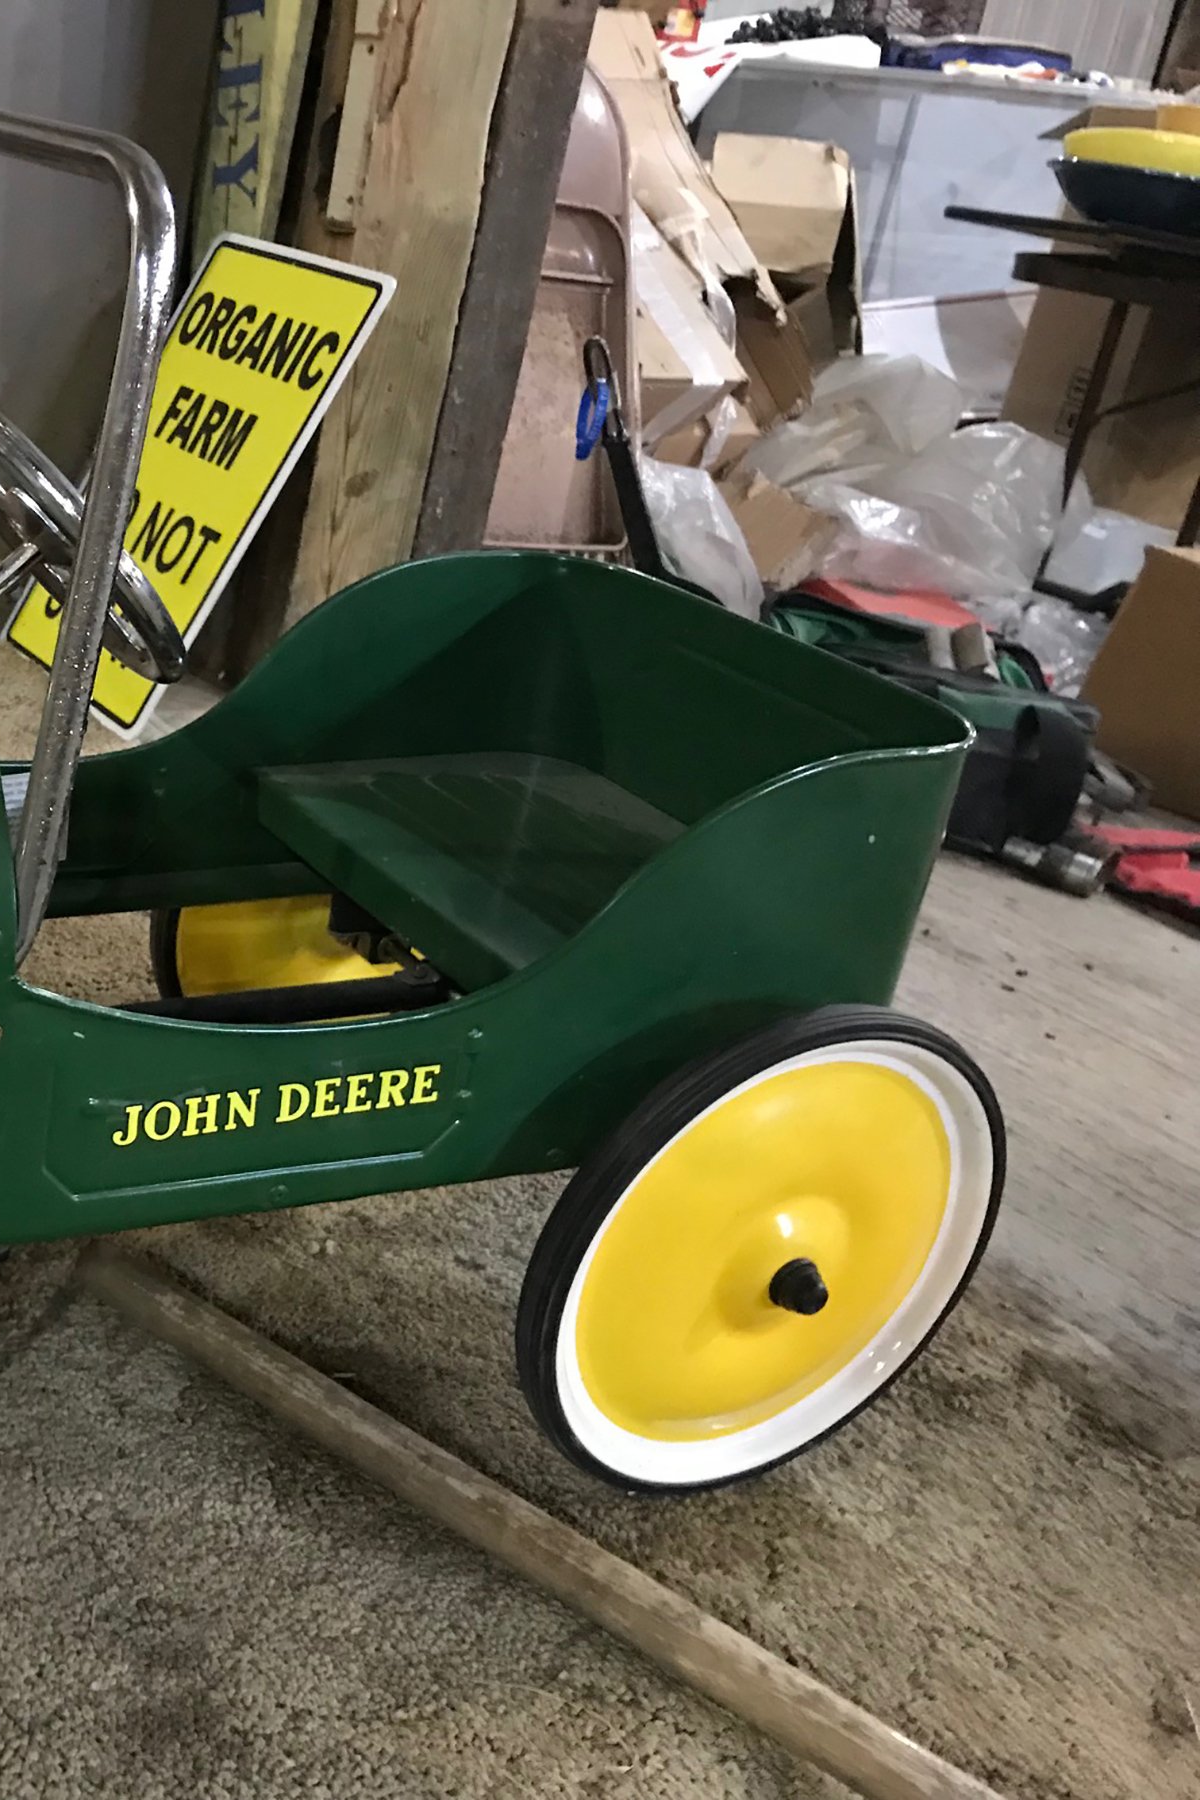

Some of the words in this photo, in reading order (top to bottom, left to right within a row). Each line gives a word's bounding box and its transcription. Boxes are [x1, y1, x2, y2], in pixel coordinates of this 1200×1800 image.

[178, 291, 340, 391] ORGANIC
[154, 385, 259, 471] FARM
[130, 501, 222, 585] NOT
[112, 1087, 261, 1147] JOHN
[275, 1064, 442, 1123] DEERE
